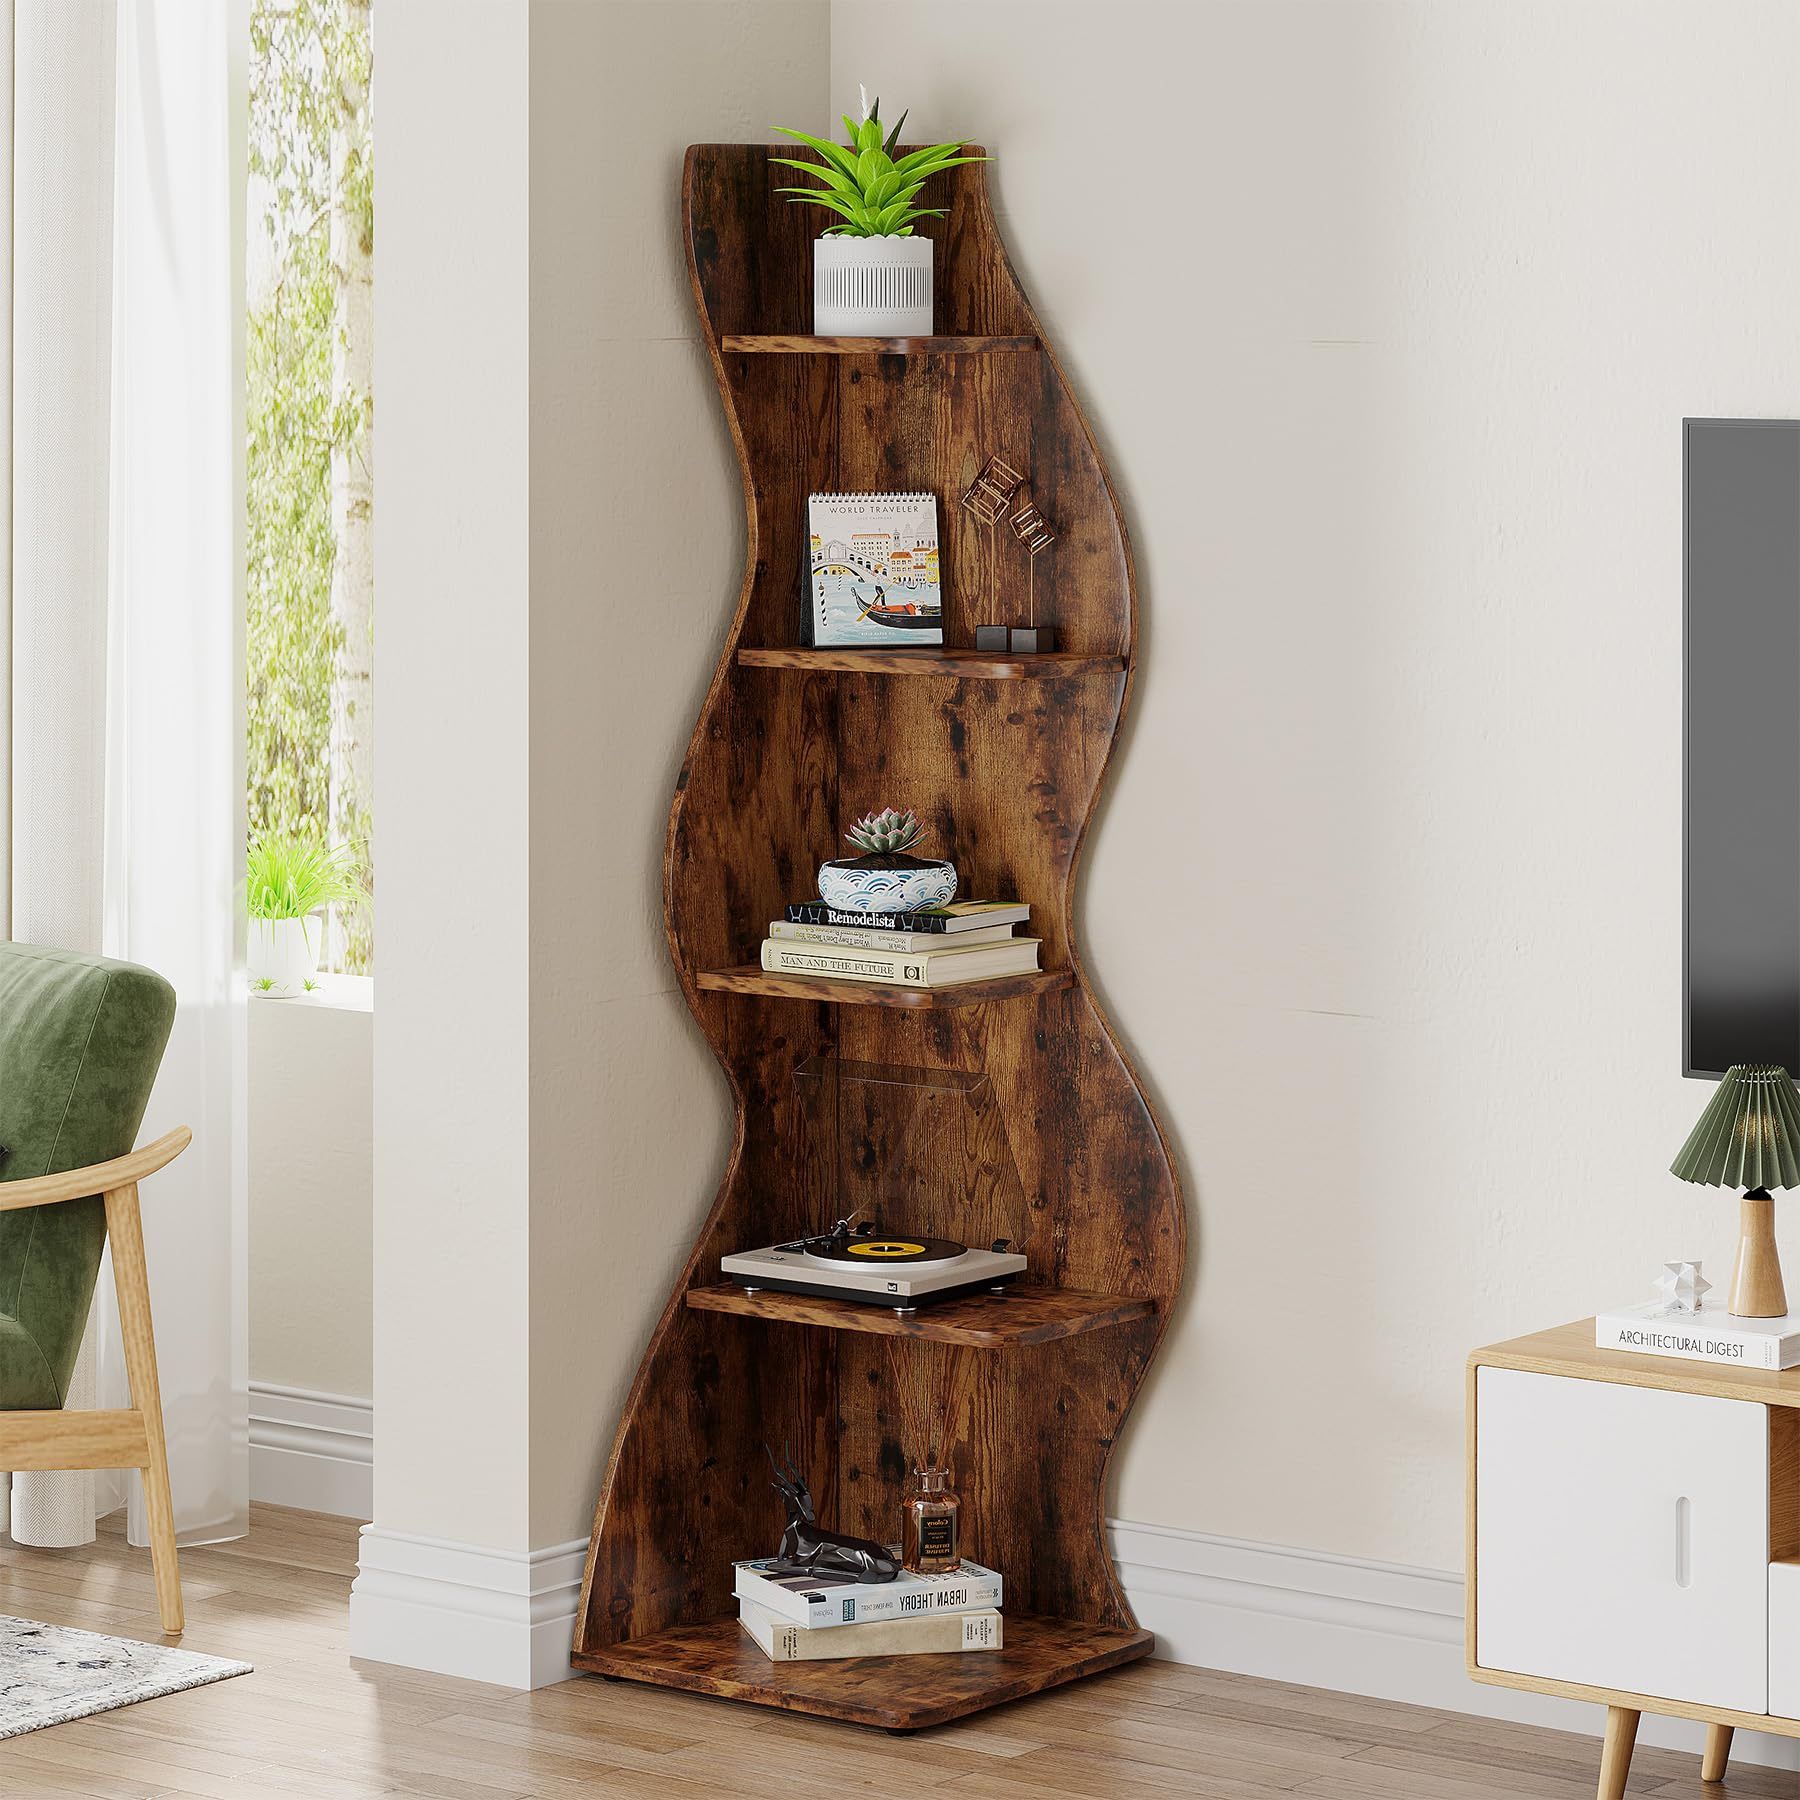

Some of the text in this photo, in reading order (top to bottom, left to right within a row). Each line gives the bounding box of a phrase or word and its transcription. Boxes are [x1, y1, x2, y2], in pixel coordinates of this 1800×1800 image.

[829, 505, 919, 514] WORLD TRAVELER
[827, 910, 896, 928] Remodelista
[823, 935, 838, 944] Don't
[838, 936, 854, 945] They
[781, 955, 894, 975] MAN AND THE FUTURE
[1618, 1330, 1703, 1353] ARCHITECTURAL
[1706, 1341, 1745, 1358] DIGEST
